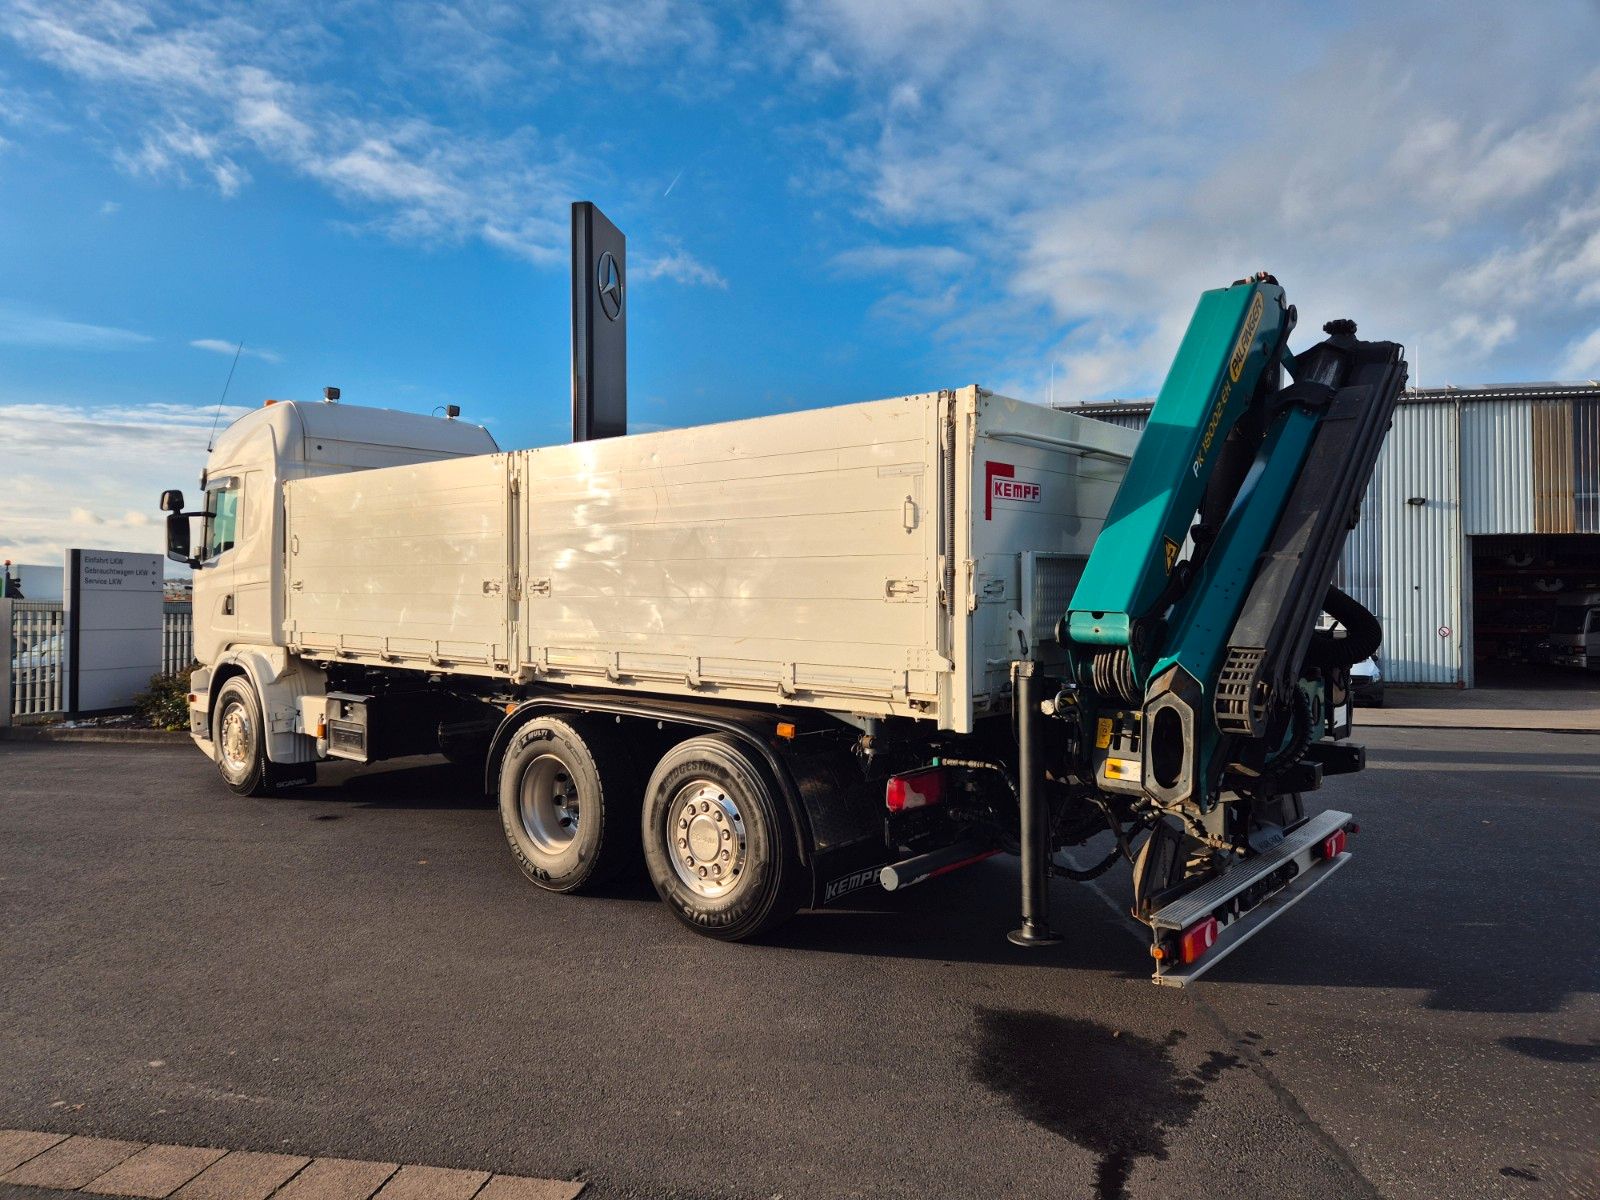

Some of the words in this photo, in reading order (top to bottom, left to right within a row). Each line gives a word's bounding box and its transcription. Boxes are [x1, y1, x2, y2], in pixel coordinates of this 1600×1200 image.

[1231, 296, 1263, 377] PALFINGER
[994, 482, 1039, 500] KEMPF
[84, 556, 109, 564] Einfahrt
[84, 566, 135, 577] Gebrauchtwagen
[135, 568, 149, 576] LKW
[84, 577, 107, 585] Service
